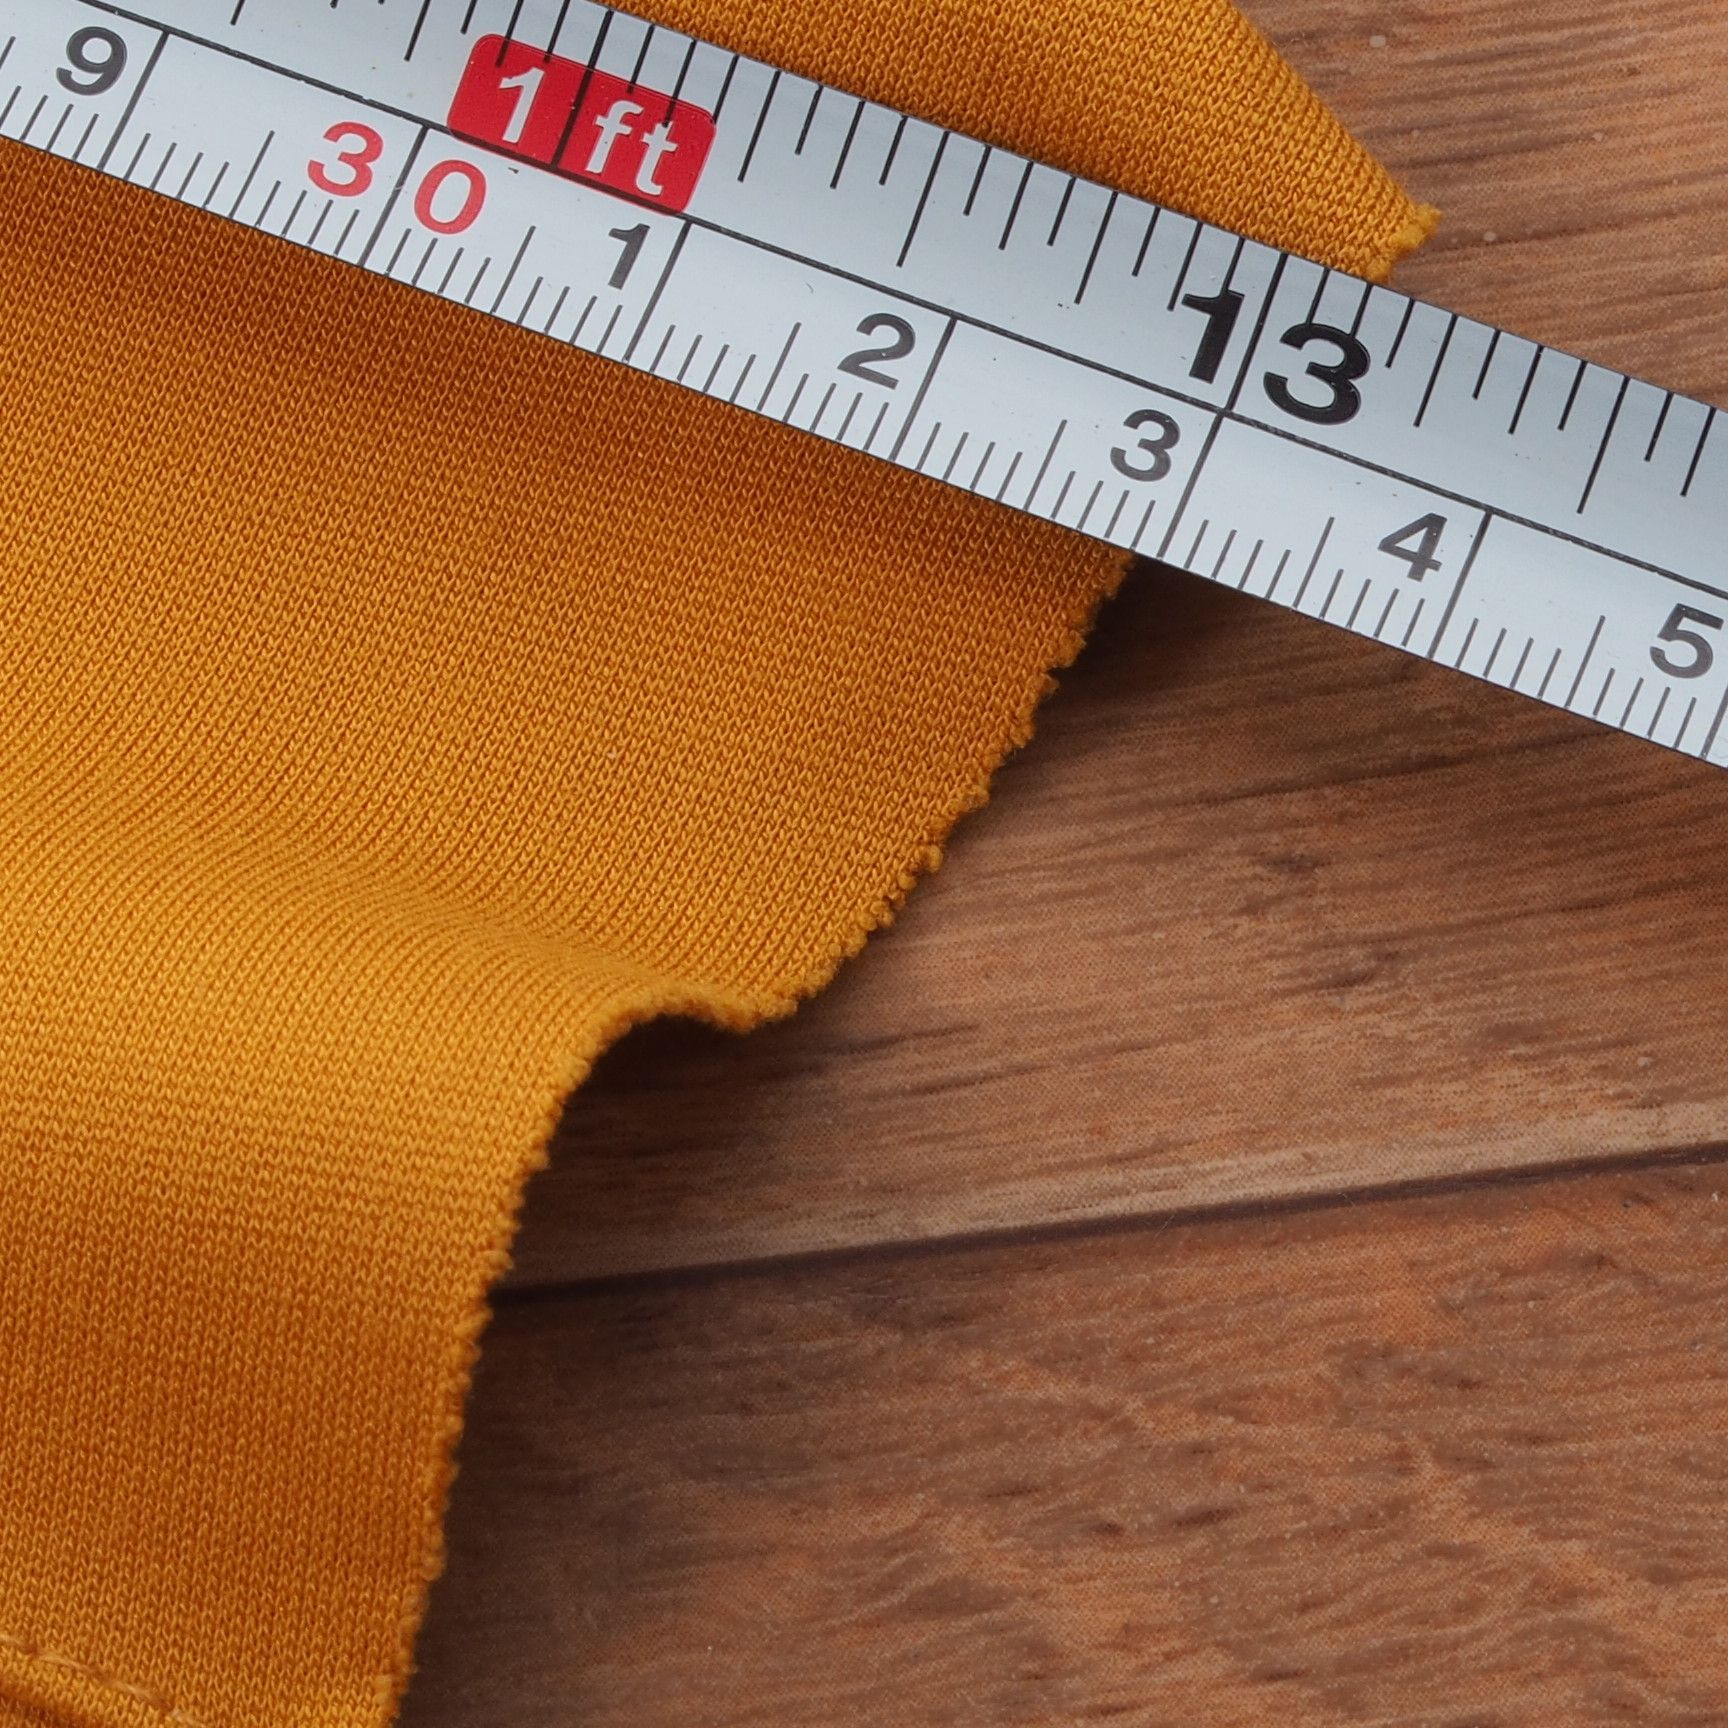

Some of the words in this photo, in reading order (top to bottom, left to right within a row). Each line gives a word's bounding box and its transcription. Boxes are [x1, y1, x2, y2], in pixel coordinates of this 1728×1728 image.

[55, 26, 128, 97] 9
[497, 67, 546, 144] 1
[586, 99, 678, 196] ft
[306, 121, 488, 234] 30
[607, 222, 651, 289] 1
[837, 313, 917, 390] 2
[1181, 289, 1371, 425] 13
[1110, 409, 1181, 483] 3
[1378, 512, 1448, 582] 4
[1649, 602, 1725, 679] 5
